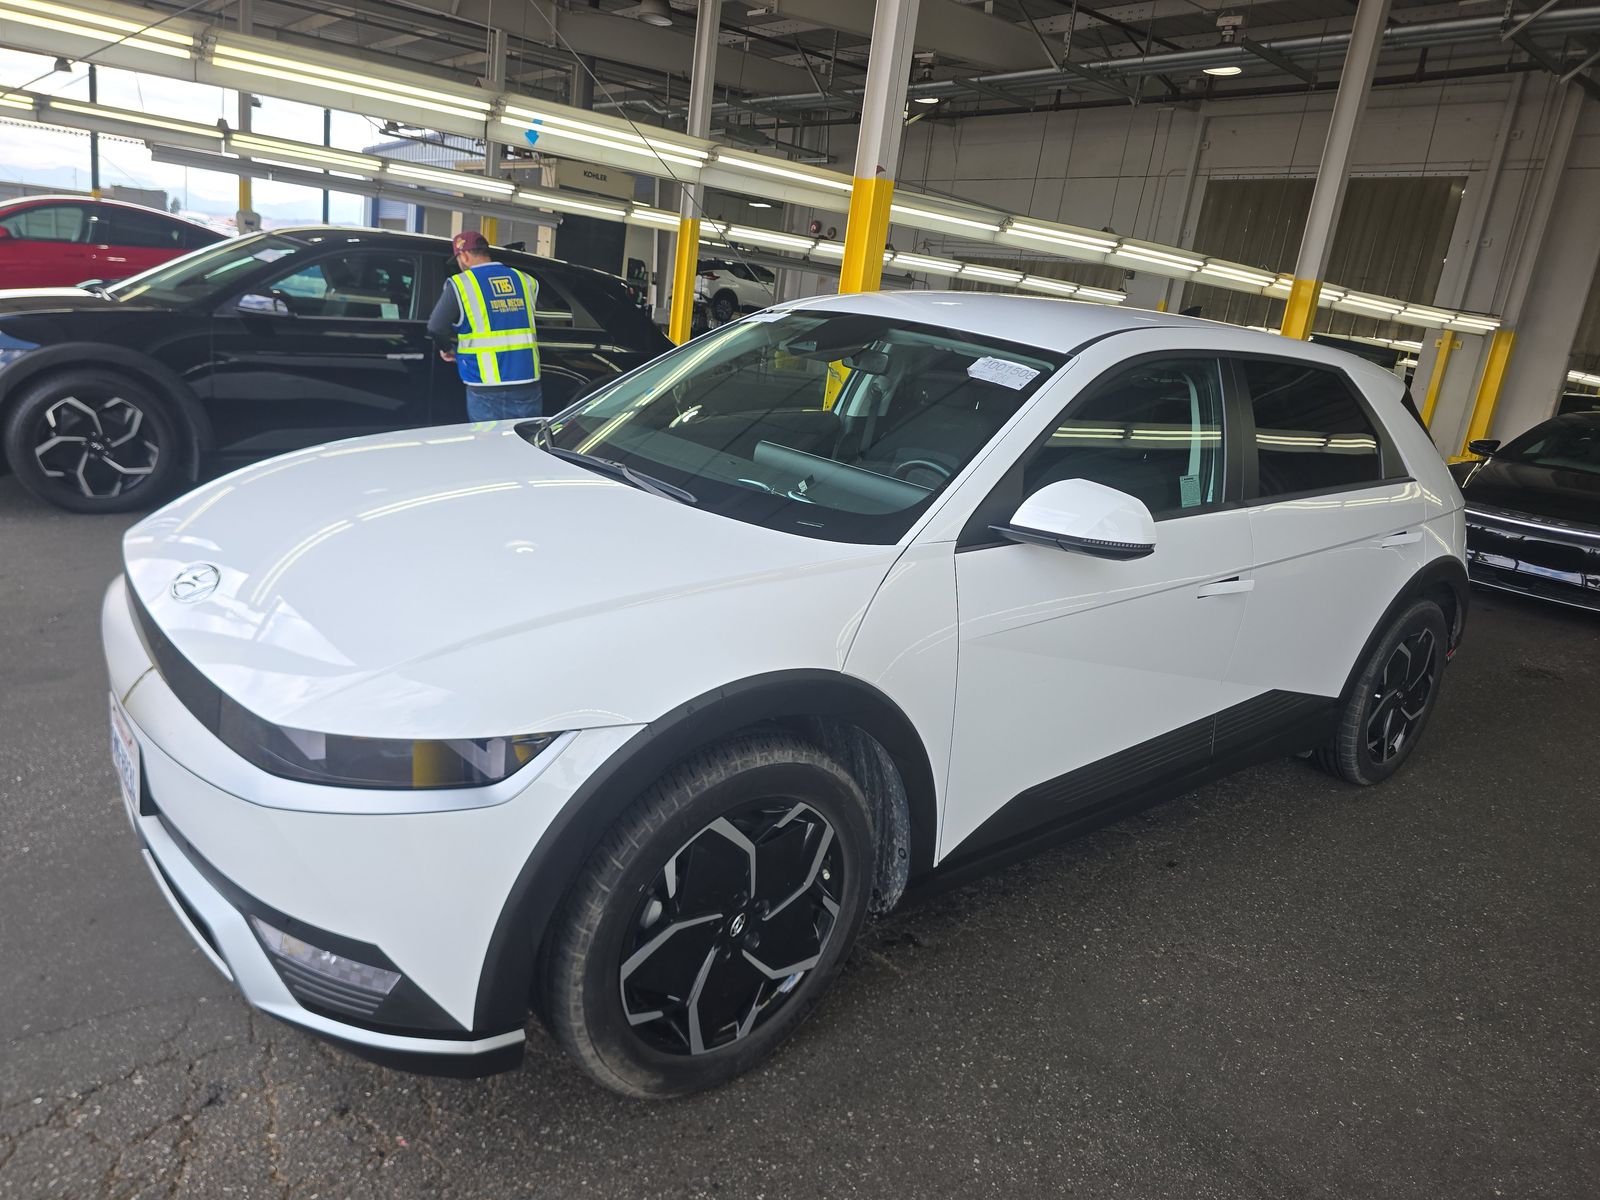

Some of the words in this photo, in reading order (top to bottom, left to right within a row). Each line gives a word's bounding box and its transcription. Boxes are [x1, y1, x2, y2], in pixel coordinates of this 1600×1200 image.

[584, 170, 608, 182] KOHLER
[490, 299, 507, 309] TOTAL
[507, 298, 525, 307] RECON
